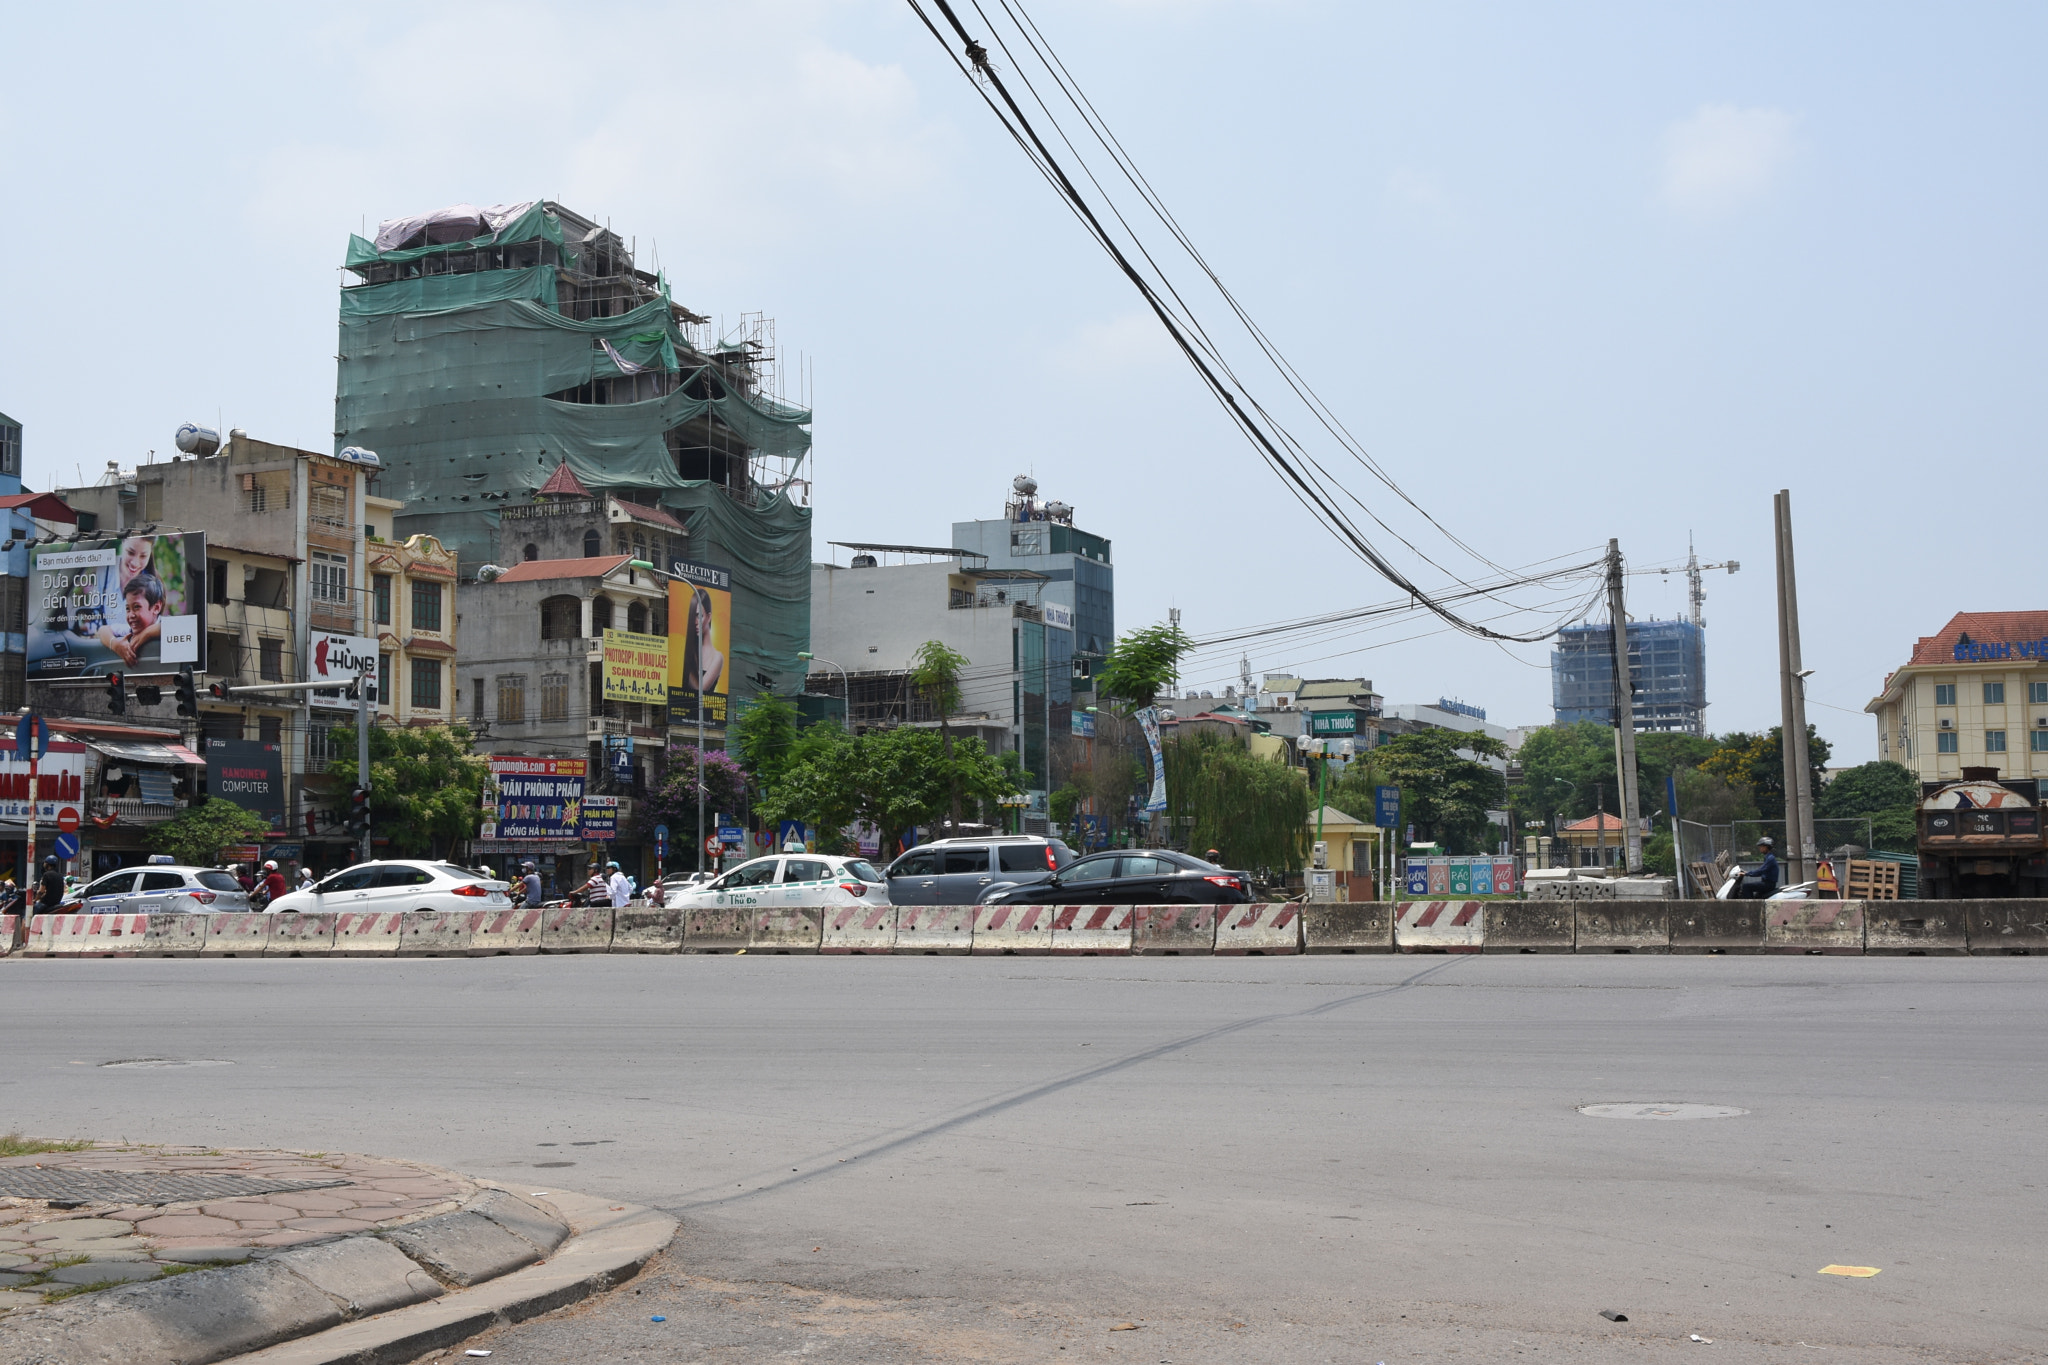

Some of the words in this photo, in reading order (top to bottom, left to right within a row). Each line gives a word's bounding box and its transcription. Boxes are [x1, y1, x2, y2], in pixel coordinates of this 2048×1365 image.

[42, 573, 69, 589] Đưa
[73, 573, 97, 587] con
[674, 562, 719, 585] SELECTIVE
[42, 591, 67, 609] đến
[72, 591, 118, 608] trường
[166, 634, 192, 643] UBER
[1954, 639, 2010, 662] BỆNH
[327, 648, 375, 672] HÙNG
[612, 667, 632, 677] SCAN
[1315, 716, 1330, 730] NHÀ
[1331, 714, 1354, 729] THUỐC
[222, 767, 268, 780] HANOINEW
[222, 780, 269, 794] COMPUTER
[503, 779, 522, 796] VĂN
[524, 779, 554, 797] PHÒNG
[556, 777, 581, 797] PHẨM
[605, 797, 615, 806] 94
[582, 828, 616, 840] Campus
[1451, 868, 1469, 881] RÁC
